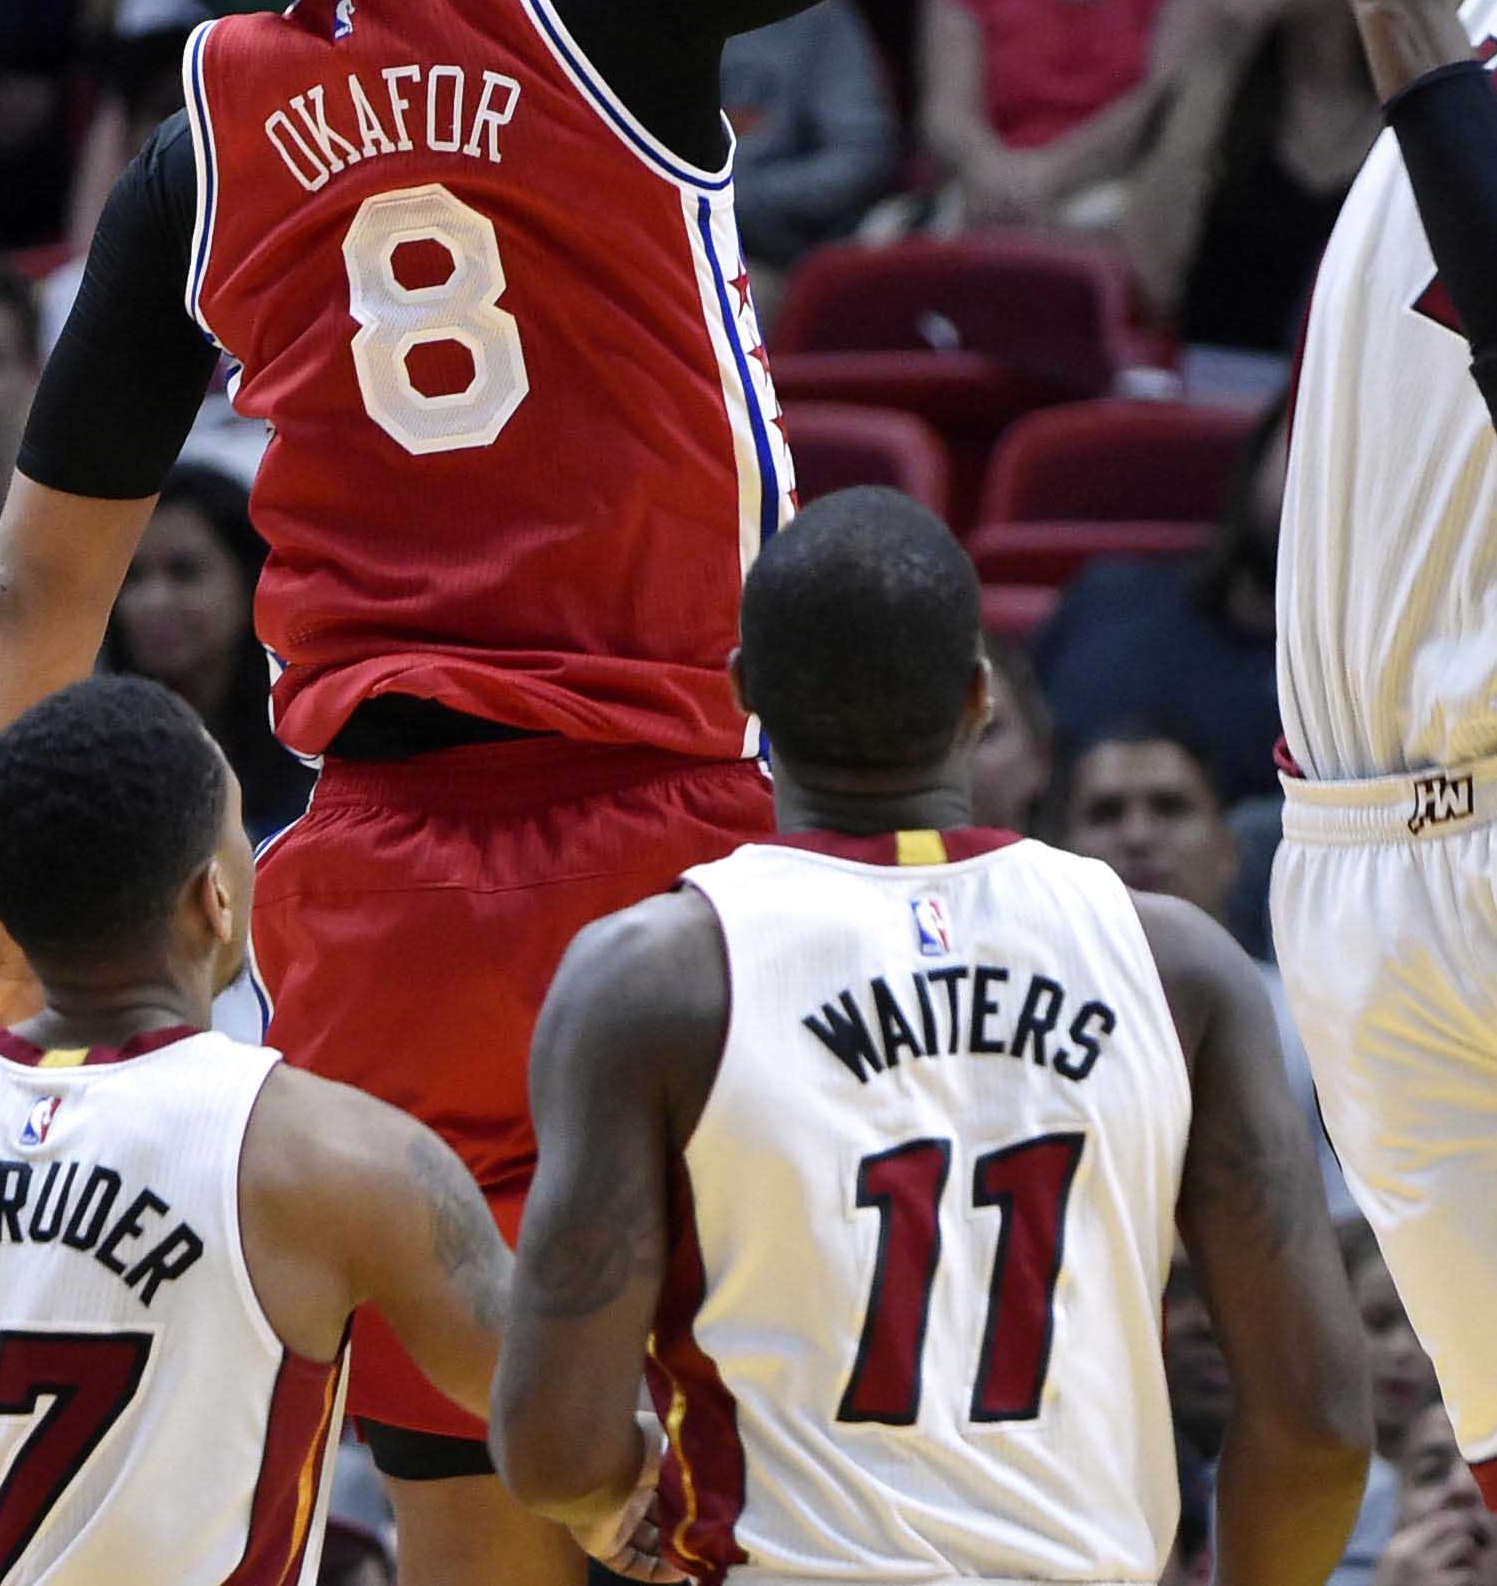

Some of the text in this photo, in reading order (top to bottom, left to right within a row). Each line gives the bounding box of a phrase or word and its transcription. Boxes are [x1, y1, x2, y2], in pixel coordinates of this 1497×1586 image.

[263, 64, 522, 192] OKAFOR
[341, 182, 531, 456] 8
[802, 964, 1117, 1084] WAITERS
[834, 1130, 1087, 1427] 11
